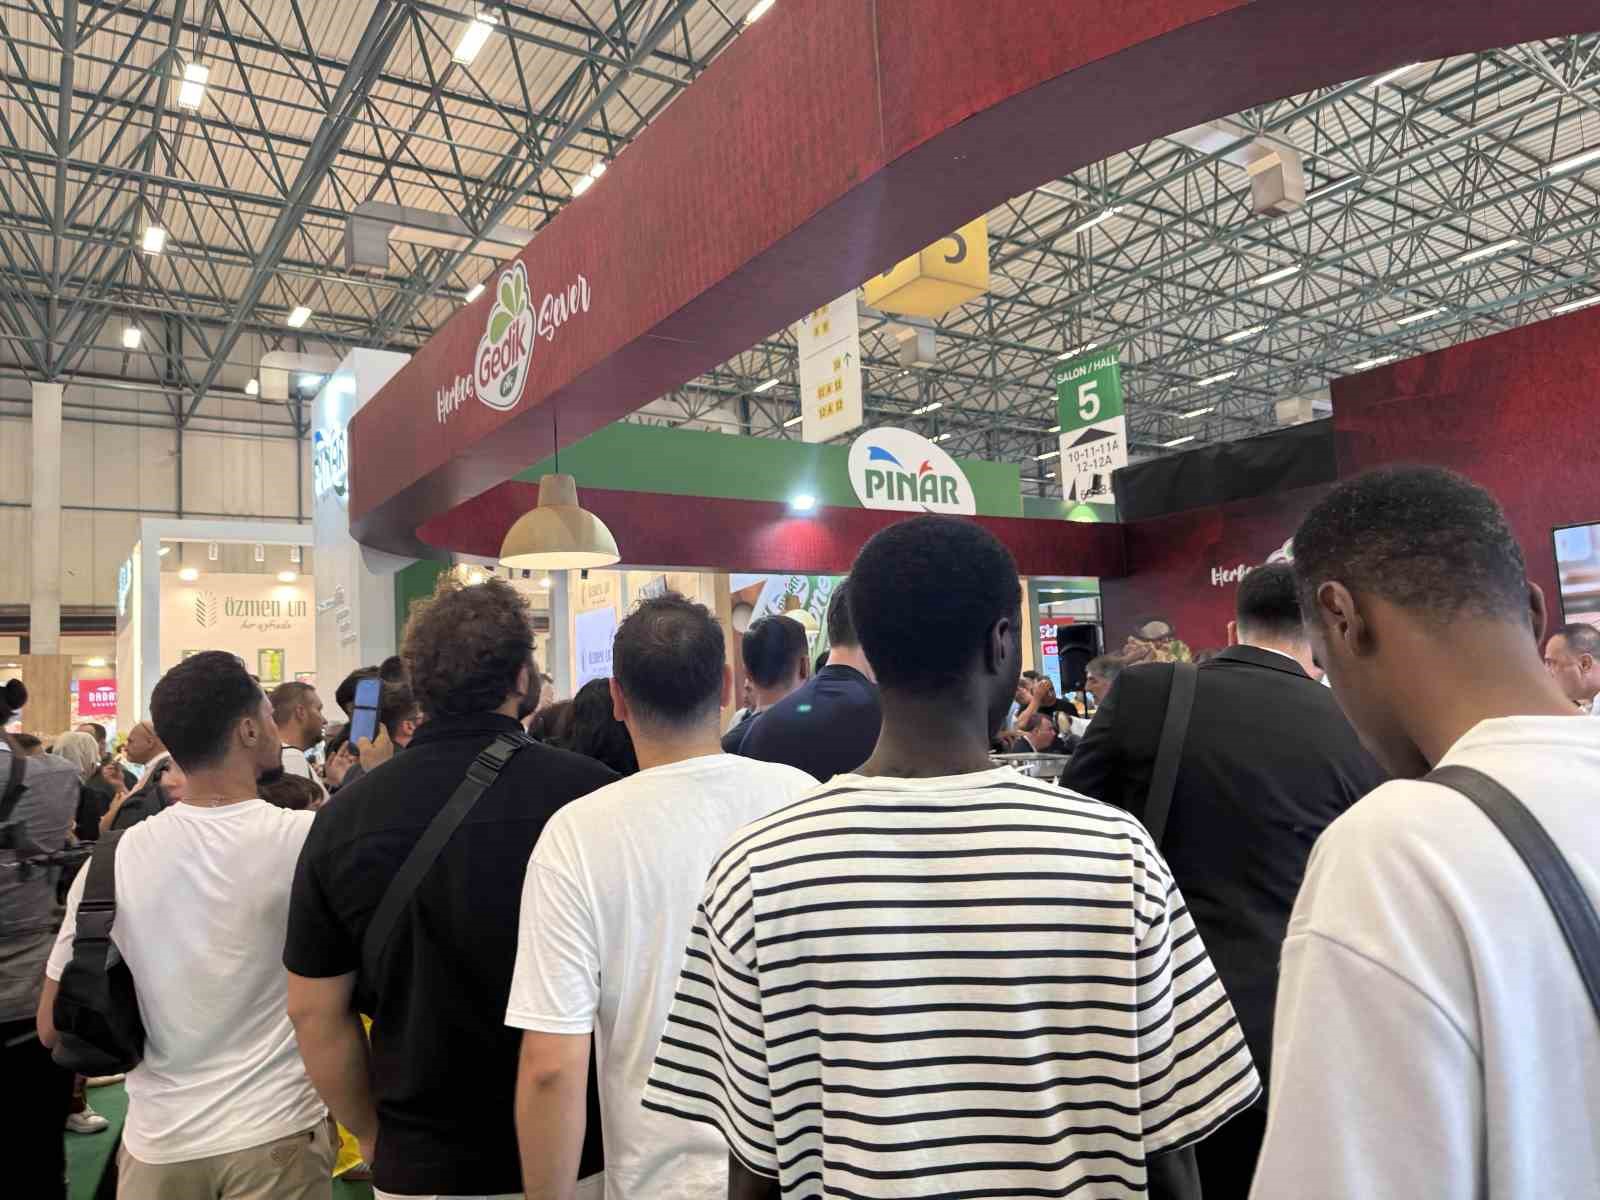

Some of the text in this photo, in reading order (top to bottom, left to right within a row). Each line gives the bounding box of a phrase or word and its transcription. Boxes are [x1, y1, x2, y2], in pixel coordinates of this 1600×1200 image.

[479, 319, 527, 388] Gedik
[537, 274, 591, 342] Sever
[1057, 365, 1087, 384] SALON
[1093, 355, 1119, 371] HALL
[1078, 380, 1100, 420] 5
[1068, 440, 1119, 462] 10-11-11A
[1077, 455, 1112, 472] 12-12A
[864, 468, 960, 504] PINAR
[224, 596, 280, 617] özmen
